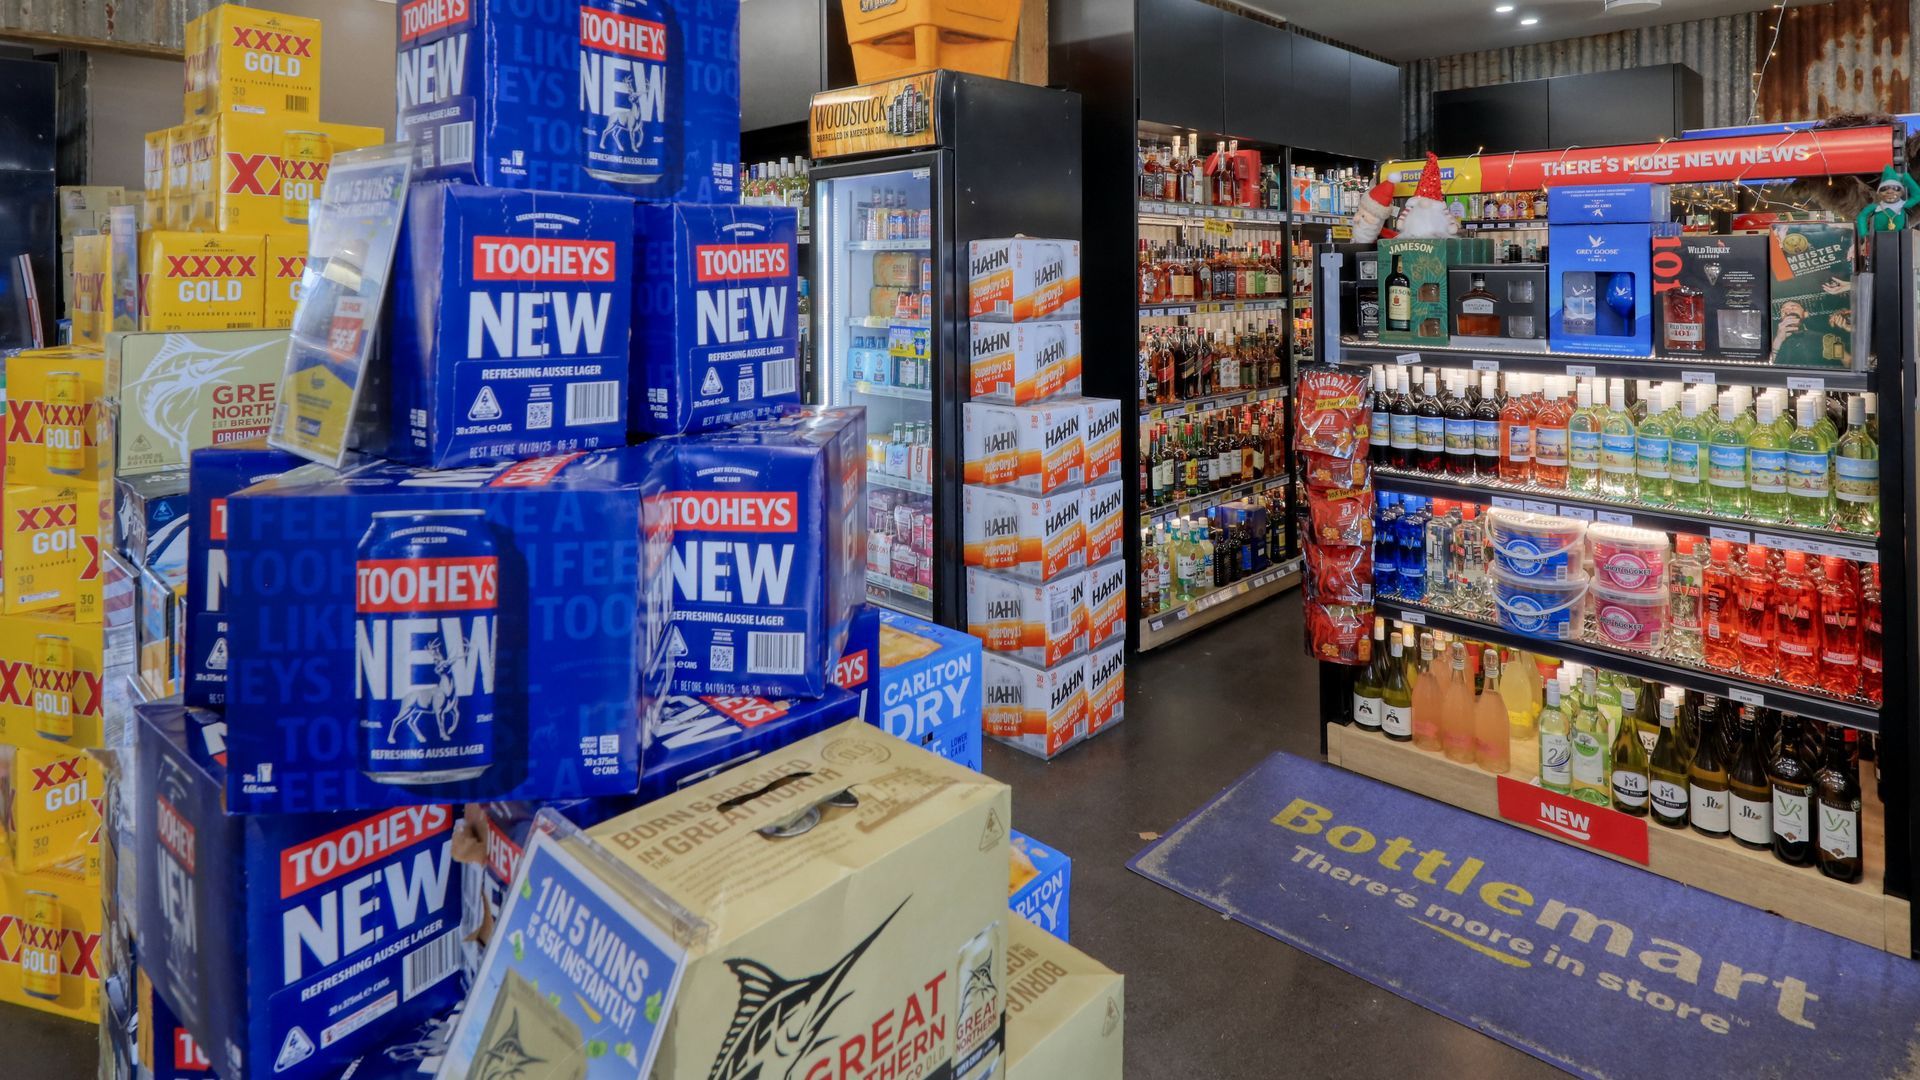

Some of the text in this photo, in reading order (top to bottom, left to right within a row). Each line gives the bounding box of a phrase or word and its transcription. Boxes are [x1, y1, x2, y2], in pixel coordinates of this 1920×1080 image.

[403, 0, 465, 35] TOOHEYS
[233, 26, 311, 57] XXXX
[581, 11, 667, 56] TOOHEYS
[244, 52, 301, 77] GOLD
[397, 33, 468, 109] NEW
[580, 50, 667, 123] NEW
[814, 95, 888, 132] WOODSTOCK
[816, 126, 886, 143] BARRELLED IN AMERICAN OAK
[1541, 145, 1813, 176] THERE'S MORE NEW NEWS
[480, 243, 610, 275] TOOHEYS
[700, 247, 786, 276] TOOHEYS
[972, 247, 1009, 277] HAHN
[1388, 242, 1434, 255] JAMESON
[1687, 245, 1731, 254] WILD TURKEY
[1787, 244, 1842, 264] MEISTER
[1790, 254, 1836, 272] BRICKS
[167, 255, 257, 278] XXXX
[1034, 259, 1064, 288] HAHN
[1653, 236, 1683, 296] 101
[178, 279, 242, 303] GOLD
[467, 291, 612, 359] NEW
[696, 286, 788, 345] NEW
[708, 346, 784, 362] REFRESHING AUSSIE LAGER
[972, 331, 1010, 357] HAHN
[1036, 339, 1066, 371] HAHN
[481, 365, 602, 380] REFRESHING AUSSIE LAGER
[1308, 376, 1353, 395] FIREBALL
[212, 382, 276, 405] GRE
[212, 403, 277, 420] NORTH
[702, 416, 714, 426] BEST
[1088, 409, 1119, 441] HAHN
[46, 428, 81, 450] GOLD
[984, 429, 1018, 455] HAHN
[1045, 415, 1079, 449] HAHN
[470, 447, 487, 459] BEST
[491, 444, 515, 457] BEFORE
[557, 438, 578, 450] 06:50
[671, 497, 791, 527] TOOHEYS
[1045, 500, 1079, 537] HAHN
[1090, 489, 1121, 524] HAHN
[984, 515, 1018, 538] HAHN
[358, 563, 497, 605] TOOHEYS
[672, 540, 795, 605] NEW
[1092, 569, 1123, 607] HAHN
[80, 594, 94, 605] 30
[987, 601, 1021, 620] HAHN
[724, 612, 755, 625] AUSSIE
[755, 613, 784, 626] LAGER
[355, 615, 498, 700] NEW
[1092, 649, 1123, 690] HAHN
[681, 680, 703, 692] BEFORE
[883, 652, 972, 707] CARLTON
[987, 685, 1022, 704] HAHN
[1050, 665, 1084, 710] HAHN
[34, 691, 69, 717] GOLD
[882, 675, 972, 742] DRY
[371, 744, 485, 761] REFRESHING AUSSIE LAGER
[951, 732, 968, 748] LOWER
[602, 765, 619, 775] CANS
[612, 811, 696, 850] BORN
[691, 795, 713, 815] &
[661, 802, 762, 857] GREAT
[1541, 802, 1591, 832] NEW
[287, 803, 449, 886] TOOHEYS
[637, 847, 663, 866] IN
[1015, 869, 1063, 918] RLTON
[283, 838, 453, 986] NEW
[1270, 797, 1820, 1031] Bottlemart
[1291, 845, 1419, 909] There's
[1425, 903, 1535, 956] more
[1543, 944, 1586, 977] in
[537, 876, 650, 1002] 1 IN 5 WINS
[22, 949, 57, 974] GOLD
[301, 918, 443, 1002] REFRESHING AUSSIE LAGER
[536, 926, 636, 1035] $5K INSTANTLY!
[1010, 960, 1069, 1004] BORN
[803, 970, 947, 1080] GREAT
[956, 994, 997, 1041] GREAT
